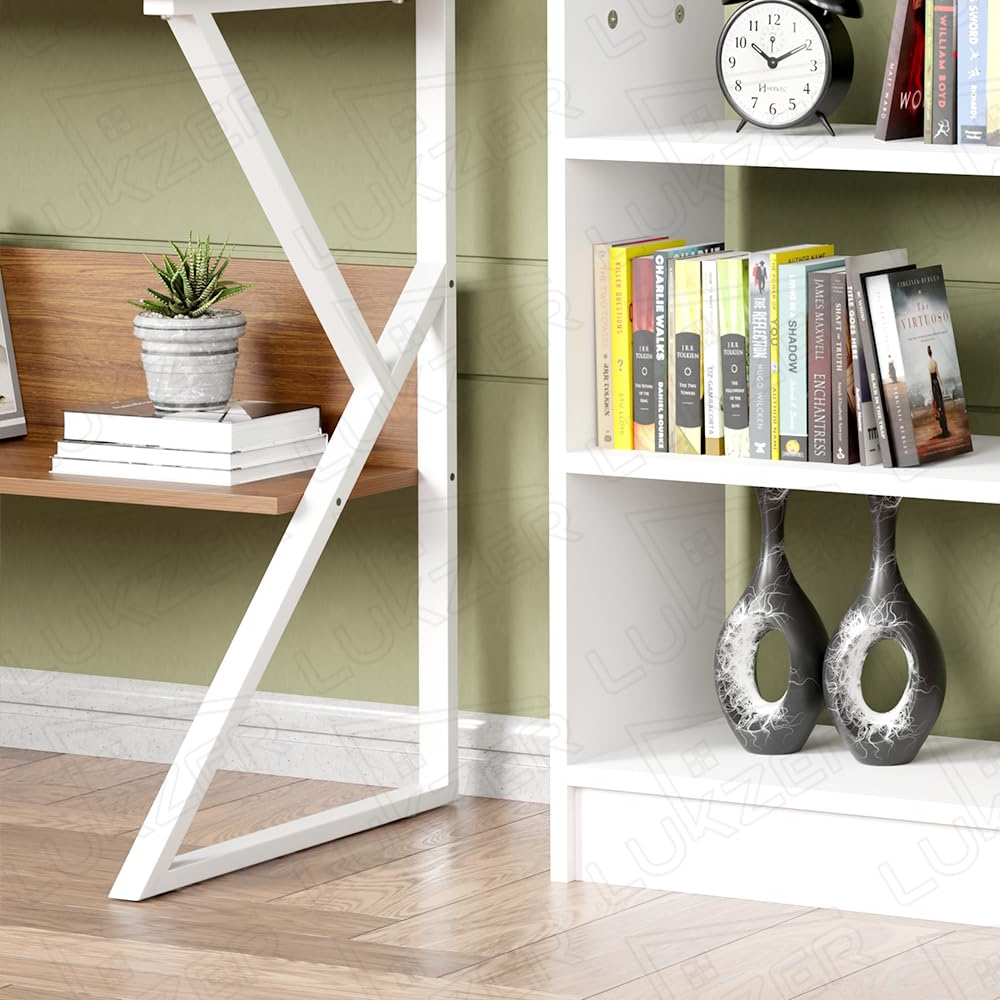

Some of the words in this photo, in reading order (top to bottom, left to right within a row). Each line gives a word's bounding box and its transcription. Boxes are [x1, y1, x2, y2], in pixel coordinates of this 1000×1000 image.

[749, 20, 758, 31] 11
[768, 14, 780, 25] 12
[793, 22, 796, 32] 1
[968, 4, 979, 44] SWORD
[735, 37, 746, 48] 10
[939, 16, 947, 69] WILLIAM
[728, 56, 736, 68] 9
[810, 60, 818, 72] 3
[735, 80, 742, 91] 8
[803, 83, 811, 94] 4
[938, 75, 946, 108] BOYD
[751, 97, 758, 108] 7
[769, 103, 777, 115] 6
[788, 98, 796, 110] 5
[655, 254, 664, 312] CHARLIE
[754, 297, 766, 310] THE
[814, 279, 824, 309] JAMES
[847, 285, 855, 307] TITLE
[615, 292, 623, 334] QUESTIONS
[917, 302, 929, 312] The
[849, 310, 857, 334] GOES
[902, 310, 949, 330] VIRTUOSO
[656, 315, 665, 361] WALKS
[752, 311, 767, 359] REFLECTION
[770, 318, 778, 347] YOU
[815, 312, 825, 361] MAXWELL
[636, 352, 653, 360] TOLKIEN
[677, 351, 699, 359] TOLKIEN
[788, 320, 798, 373] SHADOW
[756, 364, 765, 389] HUGO
[756, 392, 765, 429] WILCKEN
[814, 374, 826, 456] ENCHANTRESS
